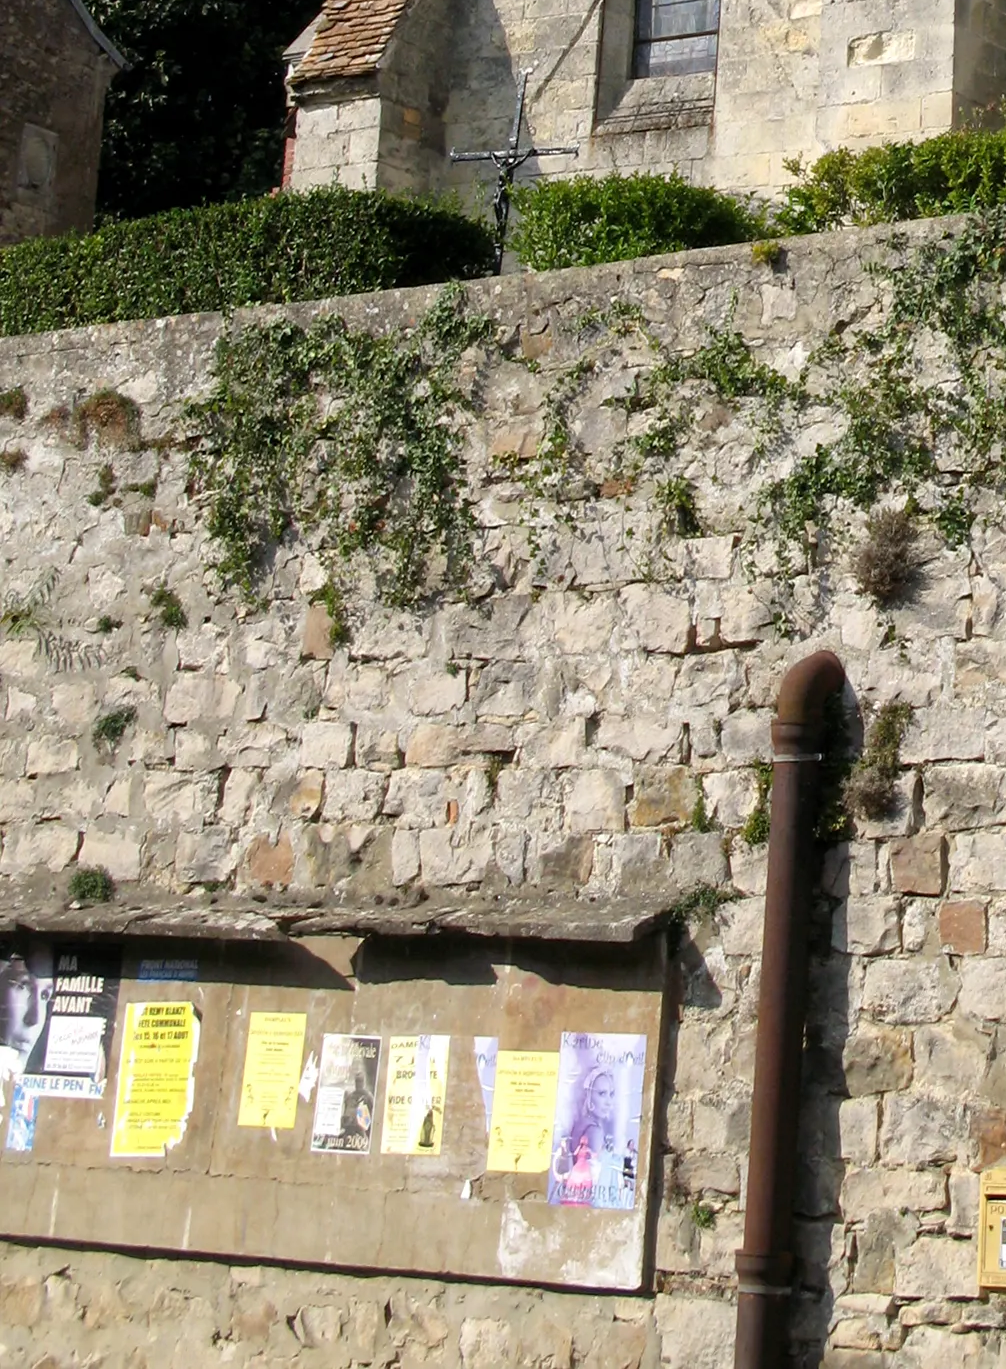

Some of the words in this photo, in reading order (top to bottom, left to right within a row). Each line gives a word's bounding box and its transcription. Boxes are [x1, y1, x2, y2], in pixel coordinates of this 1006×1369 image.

[58, 955, 78, 971] MA
[55, 976, 104, 993] FAMILLE
[52, 996, 93, 1013] AVANT
[20, 1077, 46, 1090] RINE
[49, 1079, 59, 1090] LE
[62, 1080, 84, 1092] PEN
[345, 1133, 369, 1150] 2009
